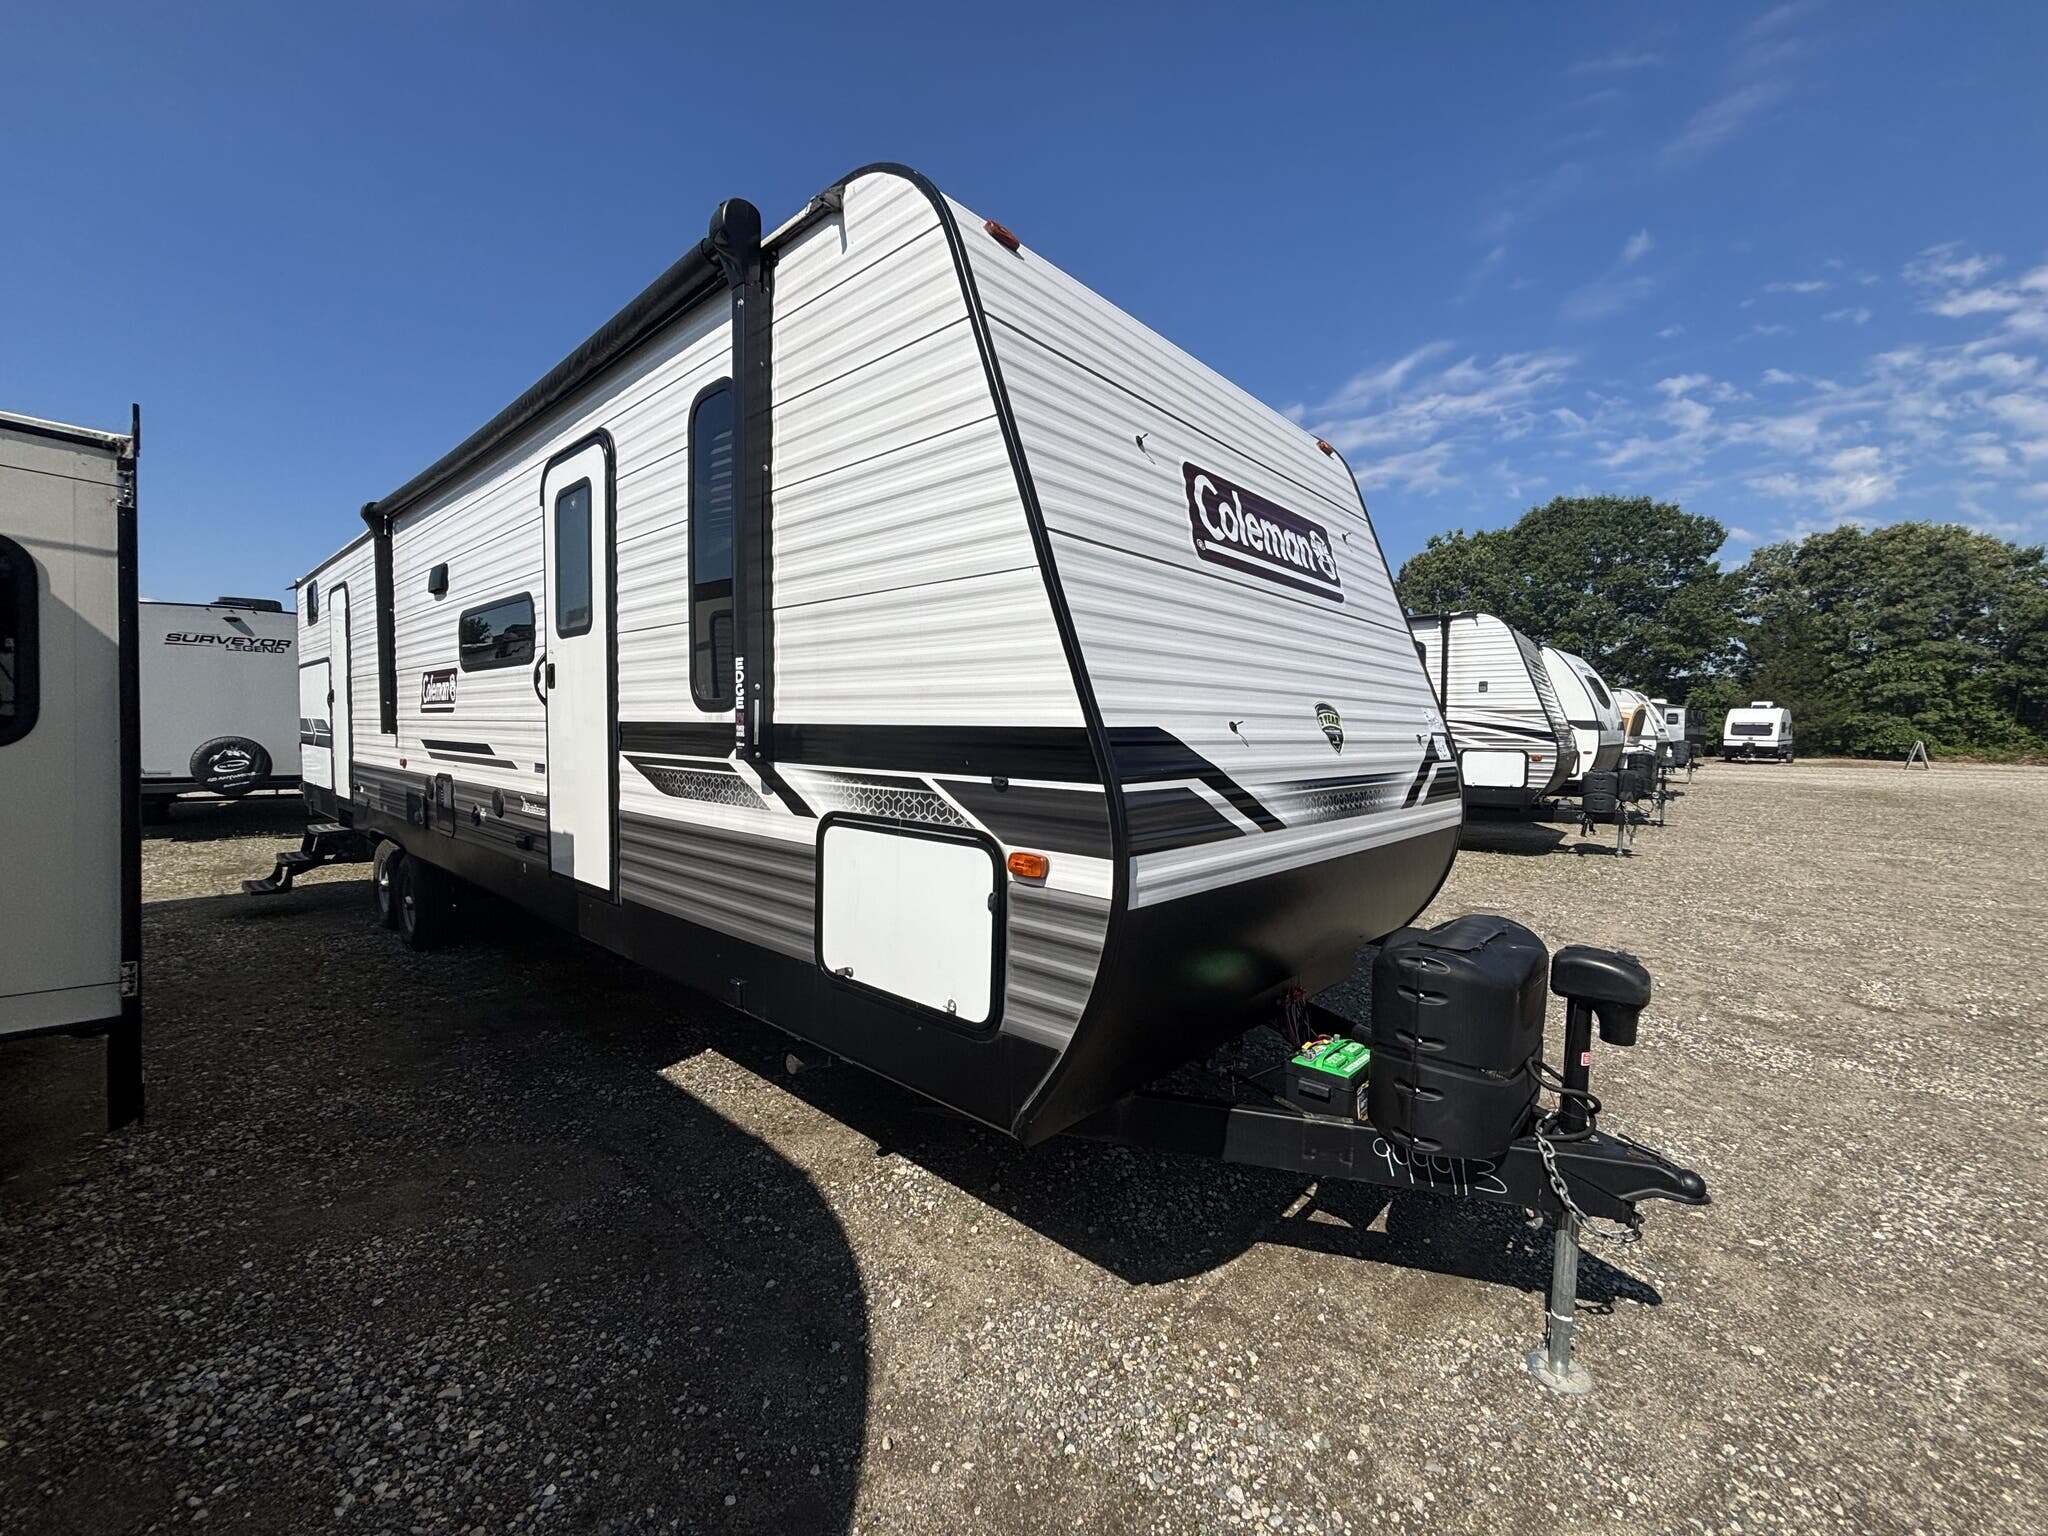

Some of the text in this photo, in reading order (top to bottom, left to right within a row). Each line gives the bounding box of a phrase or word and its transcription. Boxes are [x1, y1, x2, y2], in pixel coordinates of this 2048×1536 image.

[1194, 474, 1317, 572] Coleman
[165, 633, 292, 648] SURVEYOR
[226, 644, 285, 653] LEGEND
[423, 674, 449, 703] Coleman
[735, 656, 744, 709] EDGE
